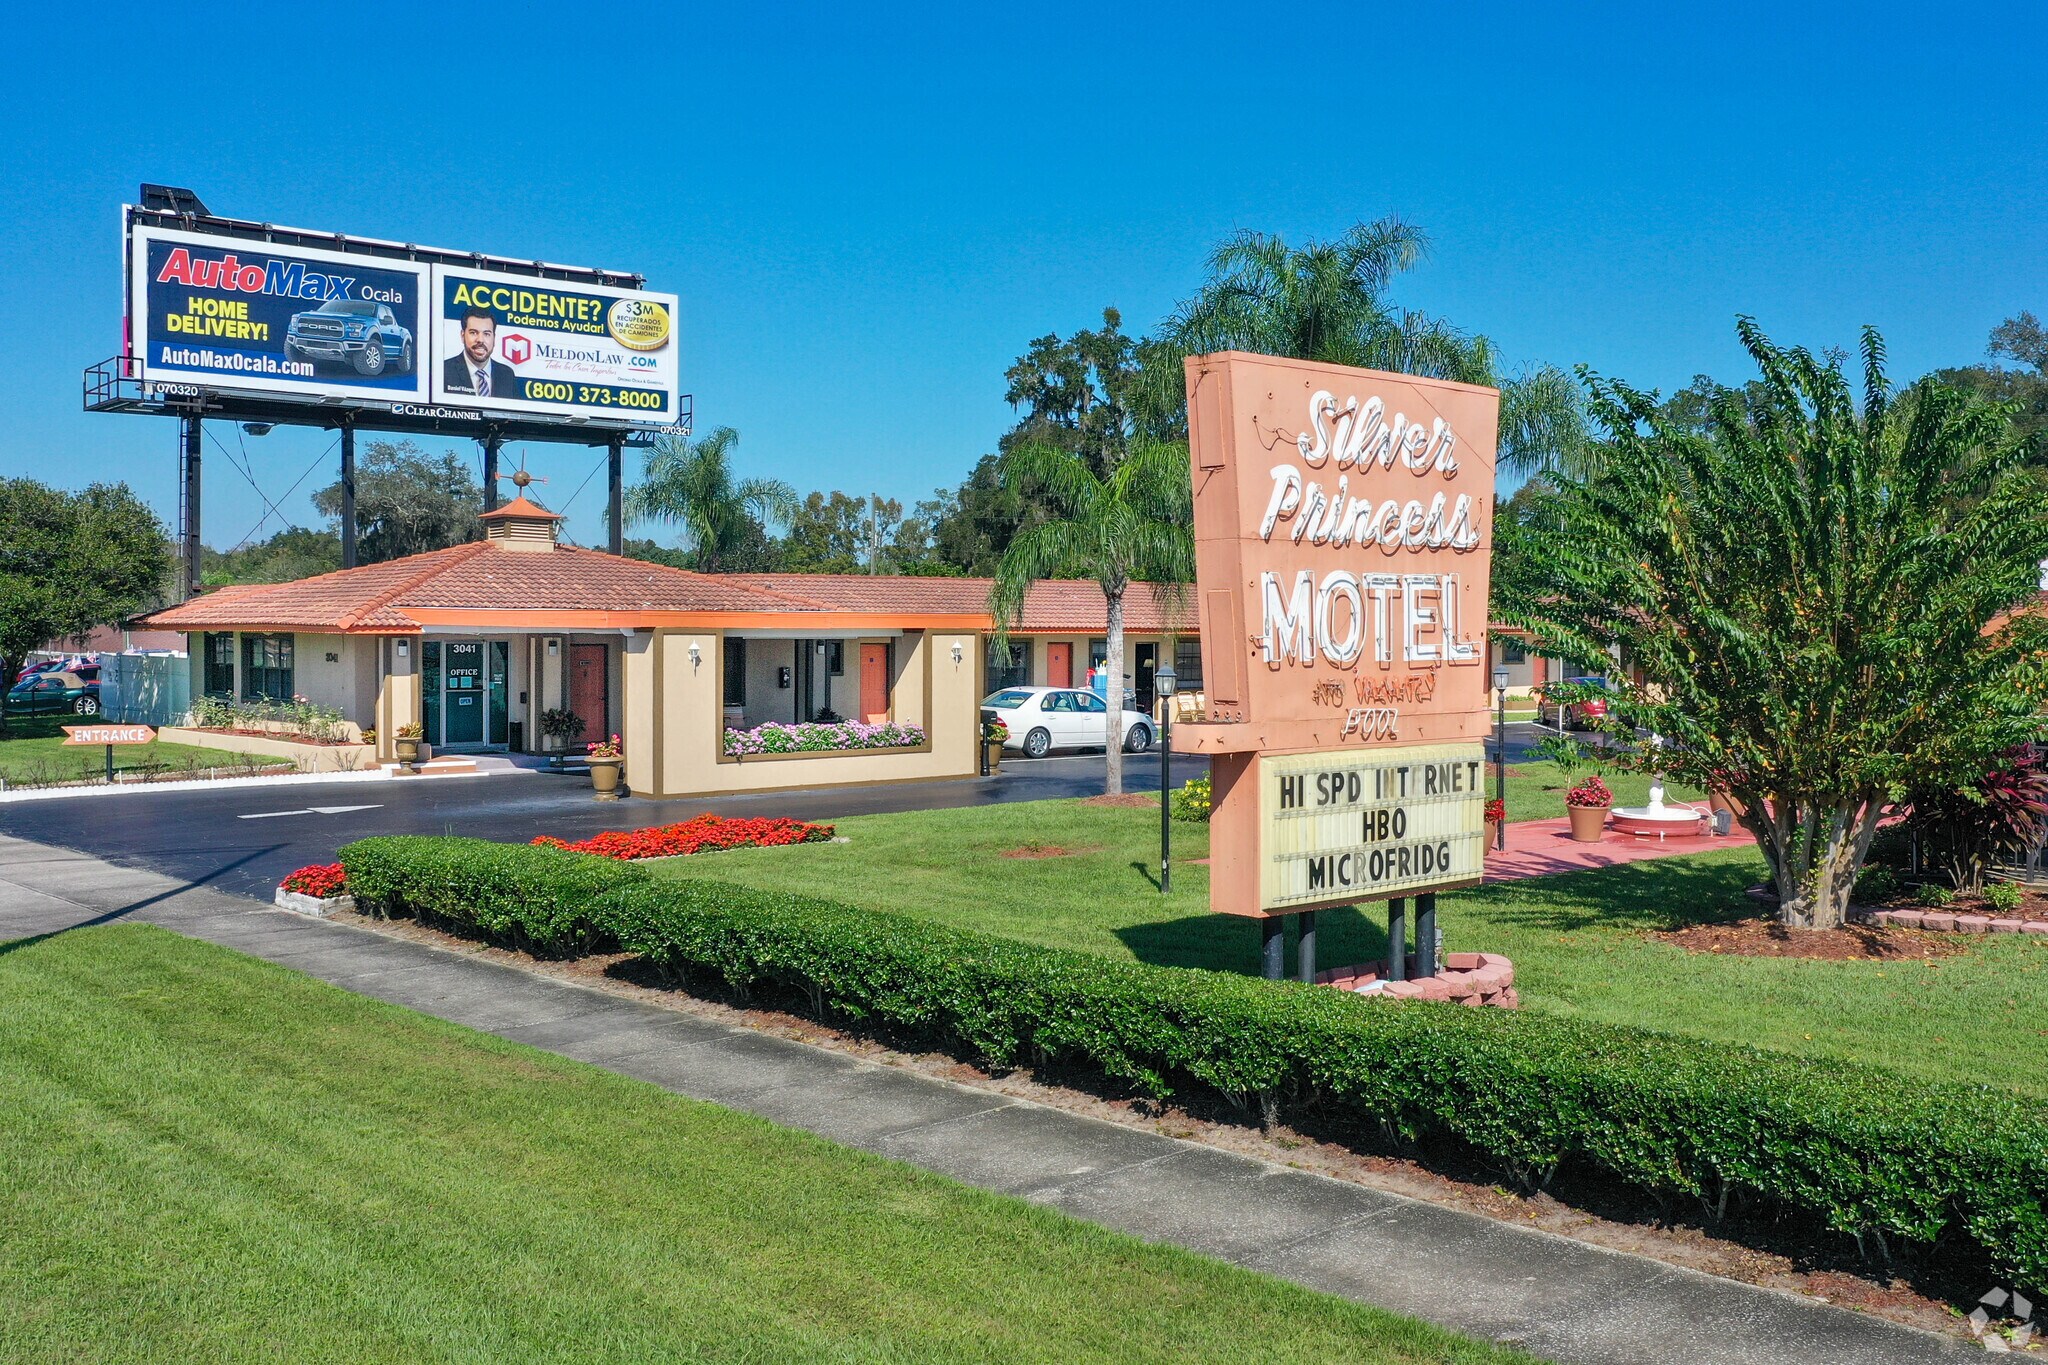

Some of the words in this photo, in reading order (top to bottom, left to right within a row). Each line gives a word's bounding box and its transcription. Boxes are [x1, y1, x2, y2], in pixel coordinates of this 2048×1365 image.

[157, 248, 356, 301] AutoMax
[361, 285, 403, 304] Ocala
[188, 297, 248, 320] HOME
[453, 283, 602, 321] ACCIDENTE?
[626, 302, 653, 316] $3M
[167, 314, 269, 341] DELIVERY!
[507, 313, 559, 328] Podemos
[562, 319, 604, 334] Ayudar!
[617, 315, 661, 325] RECUPERADOS
[625, 323, 662, 332] ACCIDENTES
[628, 329, 659, 338] CAMIONES
[161, 347, 315, 377] AutoMaxOcala.com
[157, 384, 198, 396] 070320
[525, 380, 573, 402] (800)
[579, 386, 661, 409] 373-8000
[660, 426, 690, 436] 070321
[1297, 390, 1460, 472] Silver
[1259, 463, 1482, 548] Princess
[1260, 570, 1481, 662] MOTEL
[453, 644, 476, 654] 3041
[1341, 708, 1399, 735] POOL
[74, 729, 145, 742] ENTRANCE
[1281, 775, 1304, 809] HI
[1317, 771, 1361, 806] SPD
[1363, 807, 1407, 843] HBO
[1308, 842, 1450, 890] MICROFRIDG
